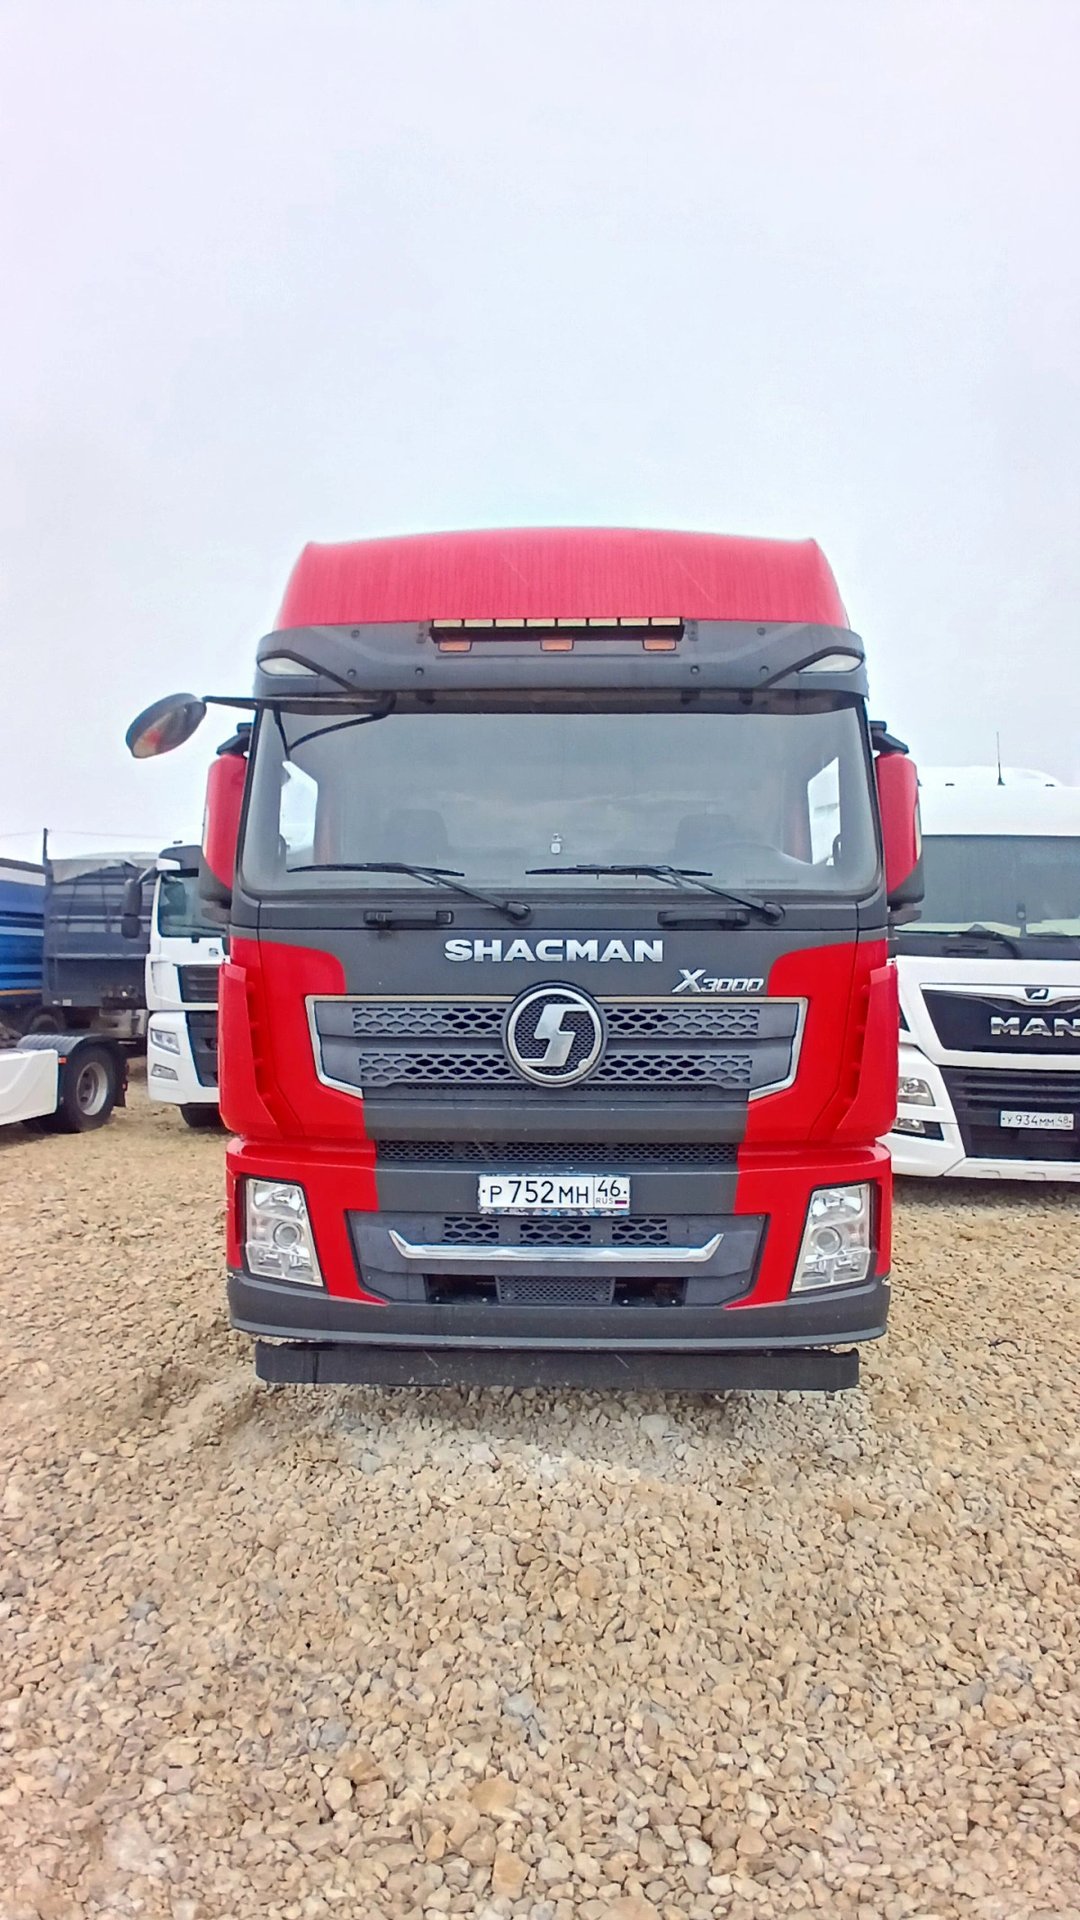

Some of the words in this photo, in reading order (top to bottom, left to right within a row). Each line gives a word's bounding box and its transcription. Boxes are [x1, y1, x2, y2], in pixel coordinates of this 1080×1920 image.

[444, 938, 663, 963] SHACMAN
[671, 968, 764, 993] X3000
[990, 1016, 1080, 1037] MAN
[597, 1179, 621, 1197] 46
[595, 1197, 614, 1205] RUS
